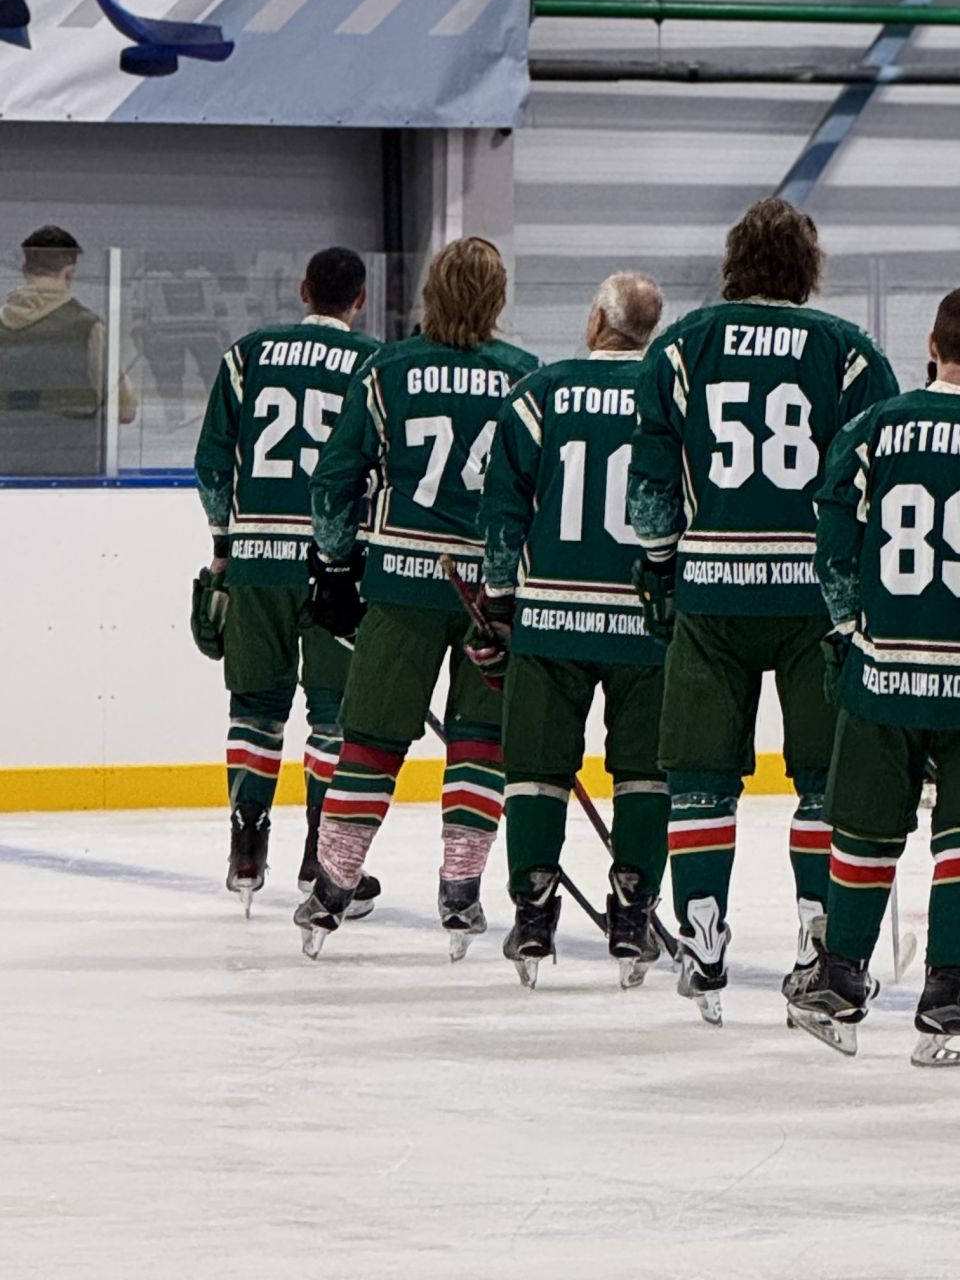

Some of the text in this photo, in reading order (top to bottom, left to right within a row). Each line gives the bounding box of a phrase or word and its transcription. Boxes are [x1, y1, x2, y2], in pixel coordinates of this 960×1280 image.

[724, 324, 809, 361] EZHOV
[251, 387, 344, 478] 25
[405, 416, 497, 508] 74
[706, 381, 820, 490] 58
[521, 607, 605, 633] ФЕДЕРАЦИЯ
